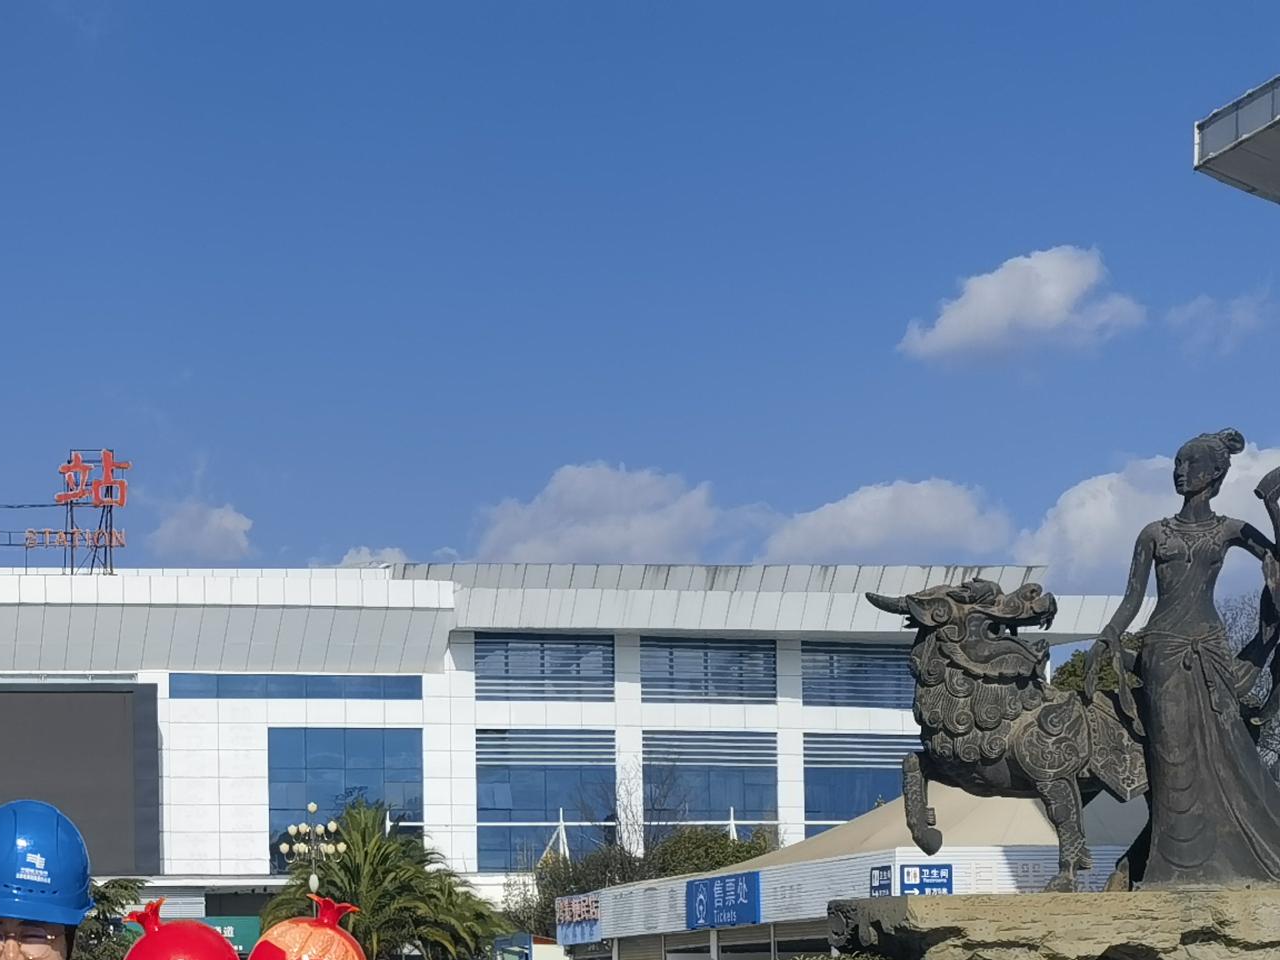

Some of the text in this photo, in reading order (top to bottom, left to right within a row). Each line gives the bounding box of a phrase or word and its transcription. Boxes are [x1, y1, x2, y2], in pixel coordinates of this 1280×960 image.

[25, 528, 126, 548] STATION
[921, 868, 949, 878] 卫生间
[714, 876, 748, 908] 售票处
[714, 909, 737, 923] Tickets
